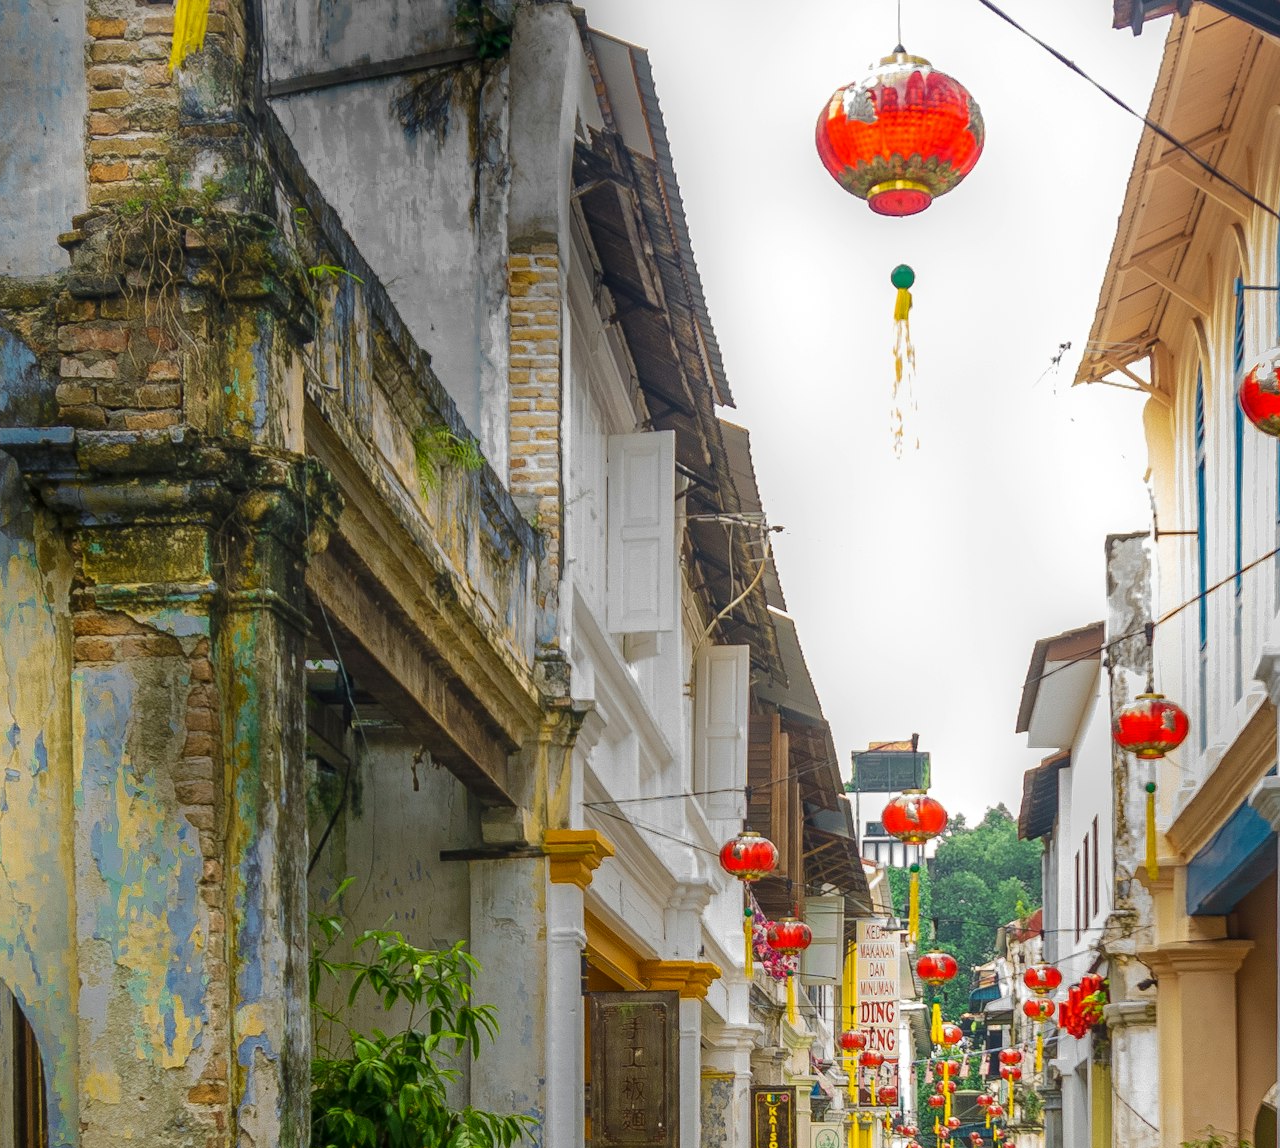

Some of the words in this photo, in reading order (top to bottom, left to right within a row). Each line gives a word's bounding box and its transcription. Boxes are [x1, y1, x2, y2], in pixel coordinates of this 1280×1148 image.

[860, 944, 895, 958] MAKANAN
[869, 962, 885, 977] DAN
[860, 981, 894, 995] MINUMAN
[861, 1001, 895, 1023] DING
[621, 1016, 647, 1132] 手工板麵
